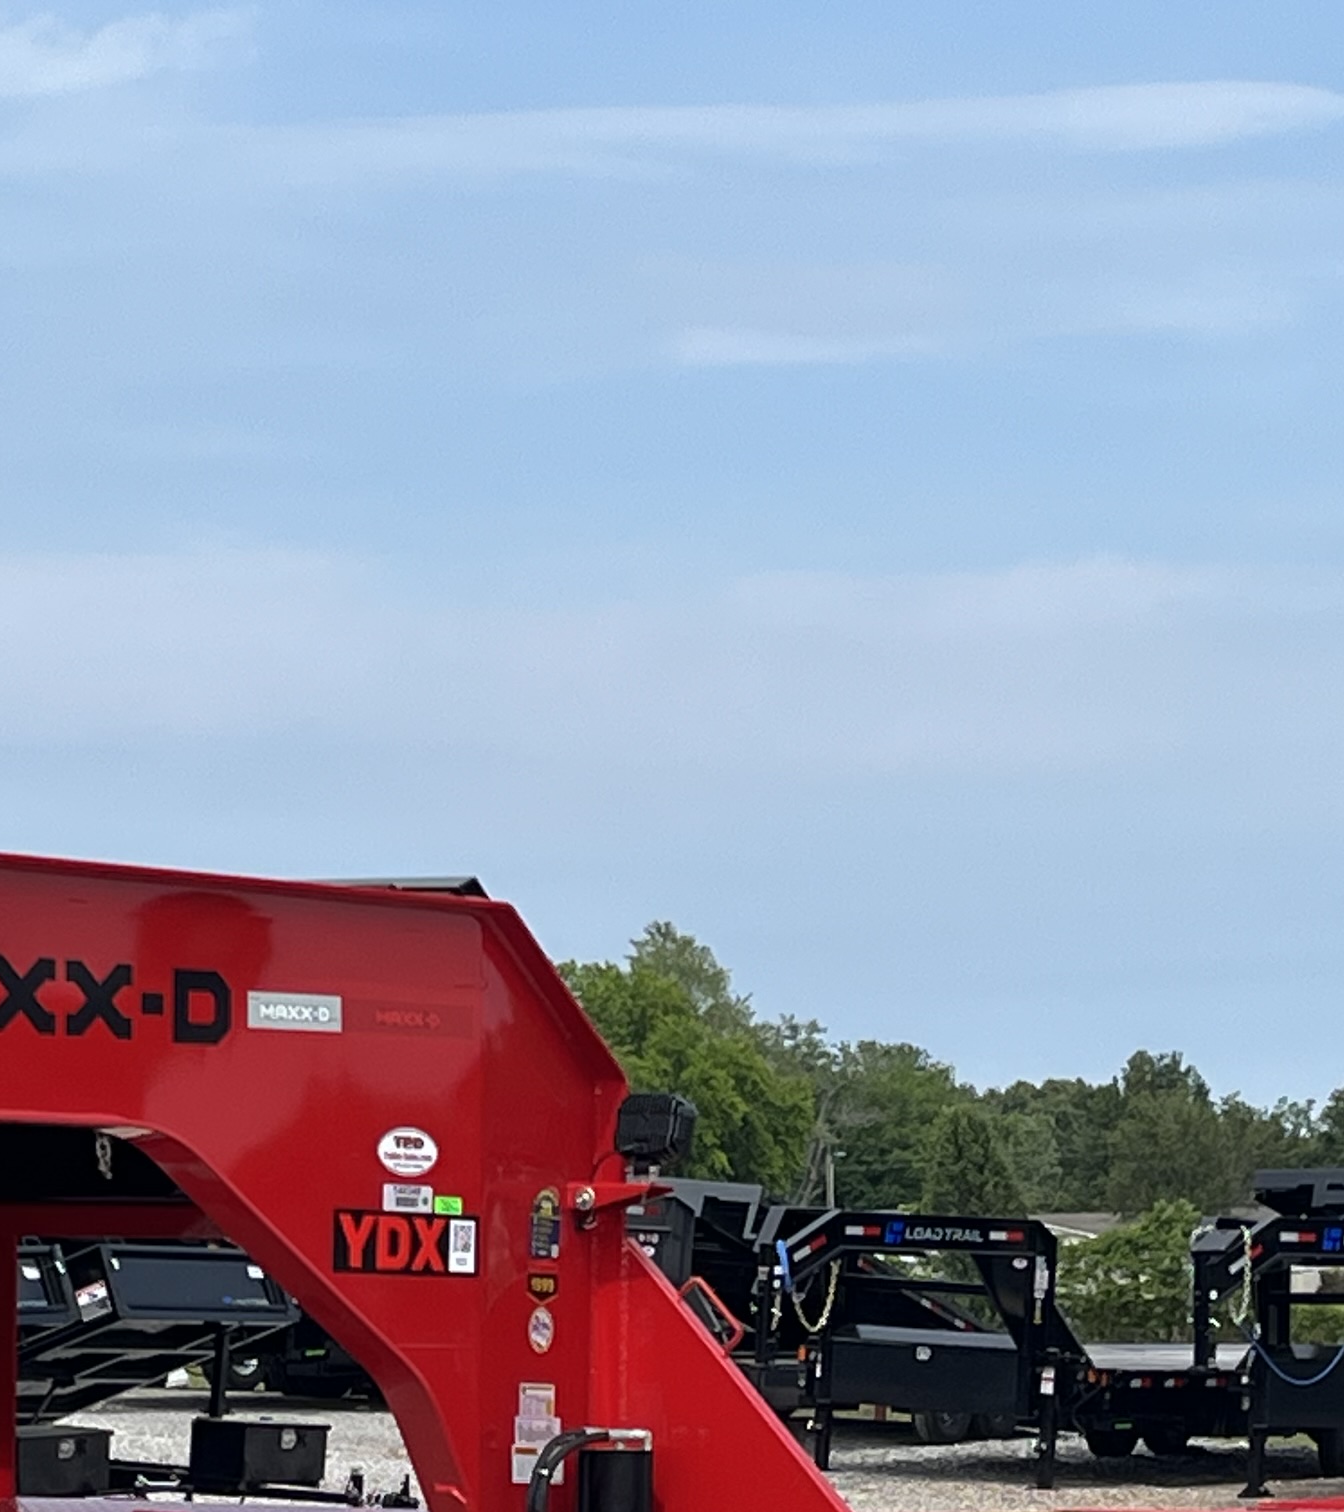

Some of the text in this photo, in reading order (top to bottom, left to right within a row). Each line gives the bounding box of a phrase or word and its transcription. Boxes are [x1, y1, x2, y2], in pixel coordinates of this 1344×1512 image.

[259, 1003, 330, 1022] MAXX-D
[339, 1213, 445, 1272] YDX
[904, 1226, 984, 1242] LOAD TRAIL
